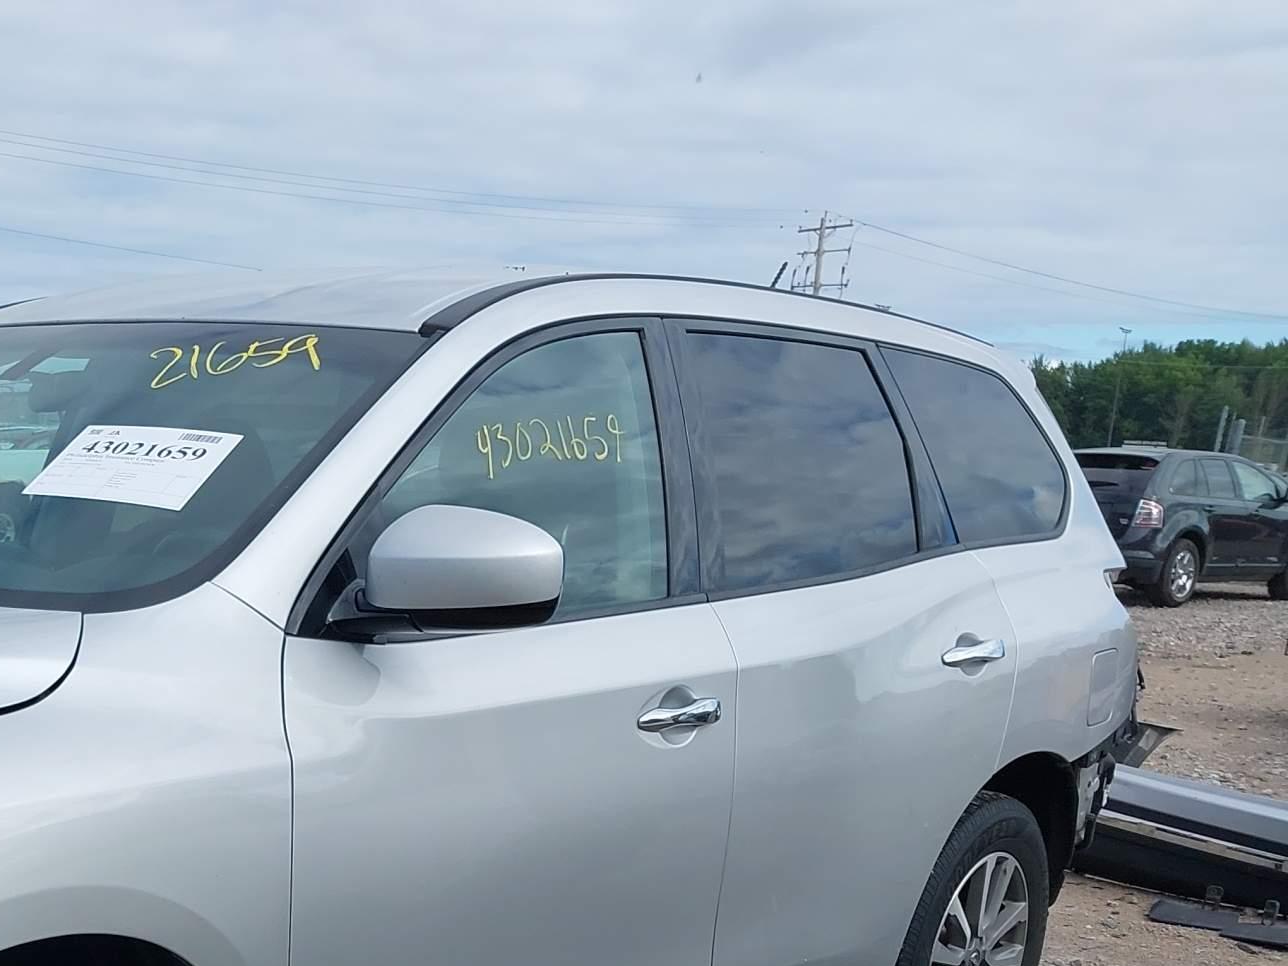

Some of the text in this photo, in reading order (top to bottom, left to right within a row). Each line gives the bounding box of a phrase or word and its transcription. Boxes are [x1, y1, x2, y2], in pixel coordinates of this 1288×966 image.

[149, 333, 321, 390] 21659
[81, 439, 209, 462] 43021659
[475, 413, 625, 480] 43021659
